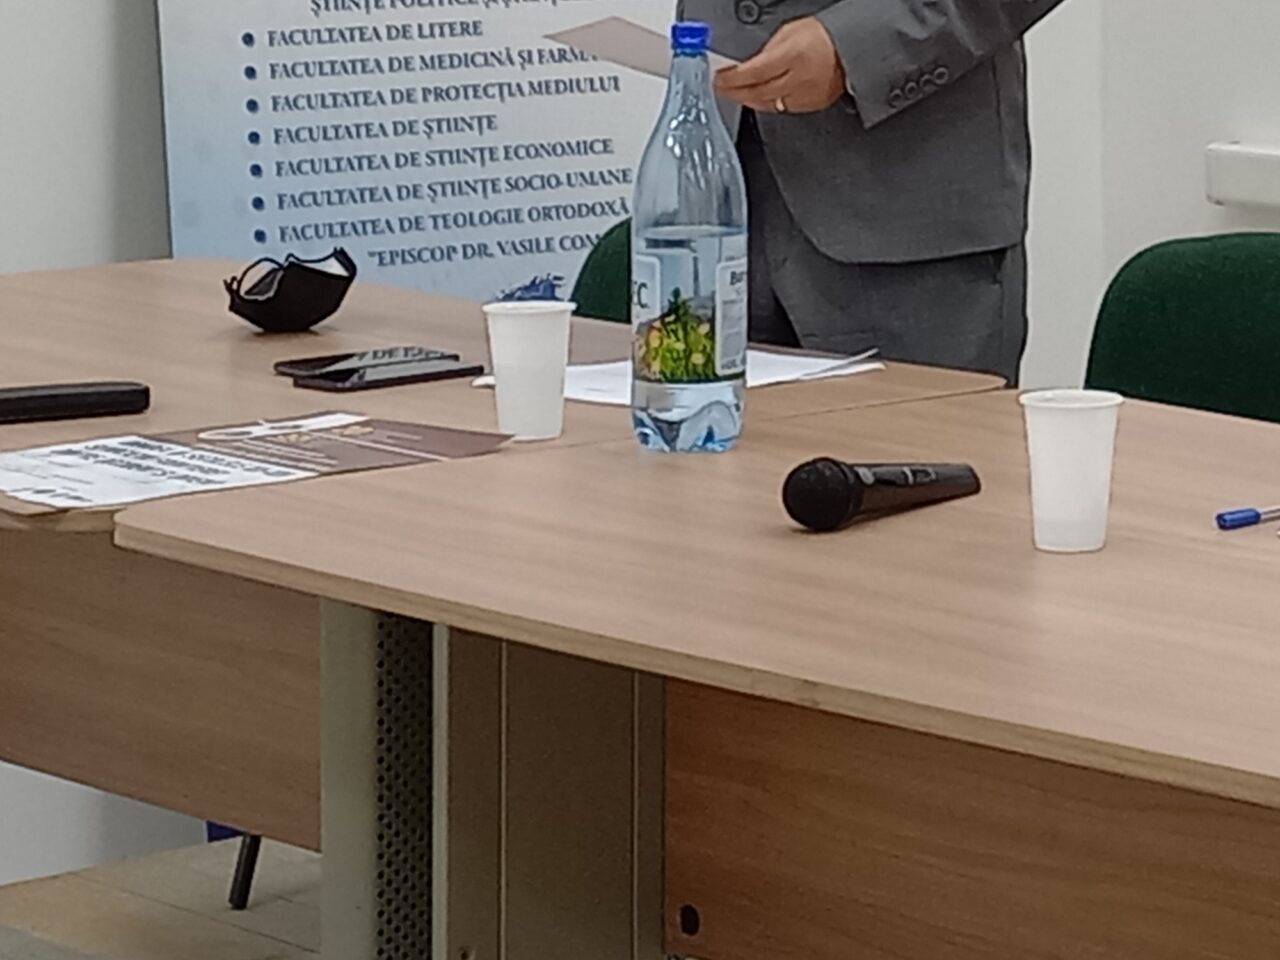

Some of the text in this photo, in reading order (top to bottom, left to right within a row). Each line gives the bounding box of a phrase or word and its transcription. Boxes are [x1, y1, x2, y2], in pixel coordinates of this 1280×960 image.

[267, 20, 484, 47] FACULTATEA DE LITERE
[269, 56, 385, 79] FACULTATEA
[388, 54, 416, 72] DE
[537, 46, 597, 64] FARM
[271, 89, 386, 113] FACULTATEA
[390, 86, 417, 105] DE
[527, 75, 621, 97] MEDIULUI
[273, 123, 389, 145] FACULTATEA
[391, 120, 419, 137] DE
[275, 156, 391, 178] FACULTATEA
[394, 152, 421, 170] DE
[503, 138, 614, 161] ECONOMICE
[276, 189, 393, 211] FACULTATEA
[395, 184, 423, 202] DE
[278, 222, 394, 244] FACULTATEA
[398, 216, 426, 234] DE
[429, 208, 525, 231] TEOLOGIE
[496, 236, 555, 257] VASILE
